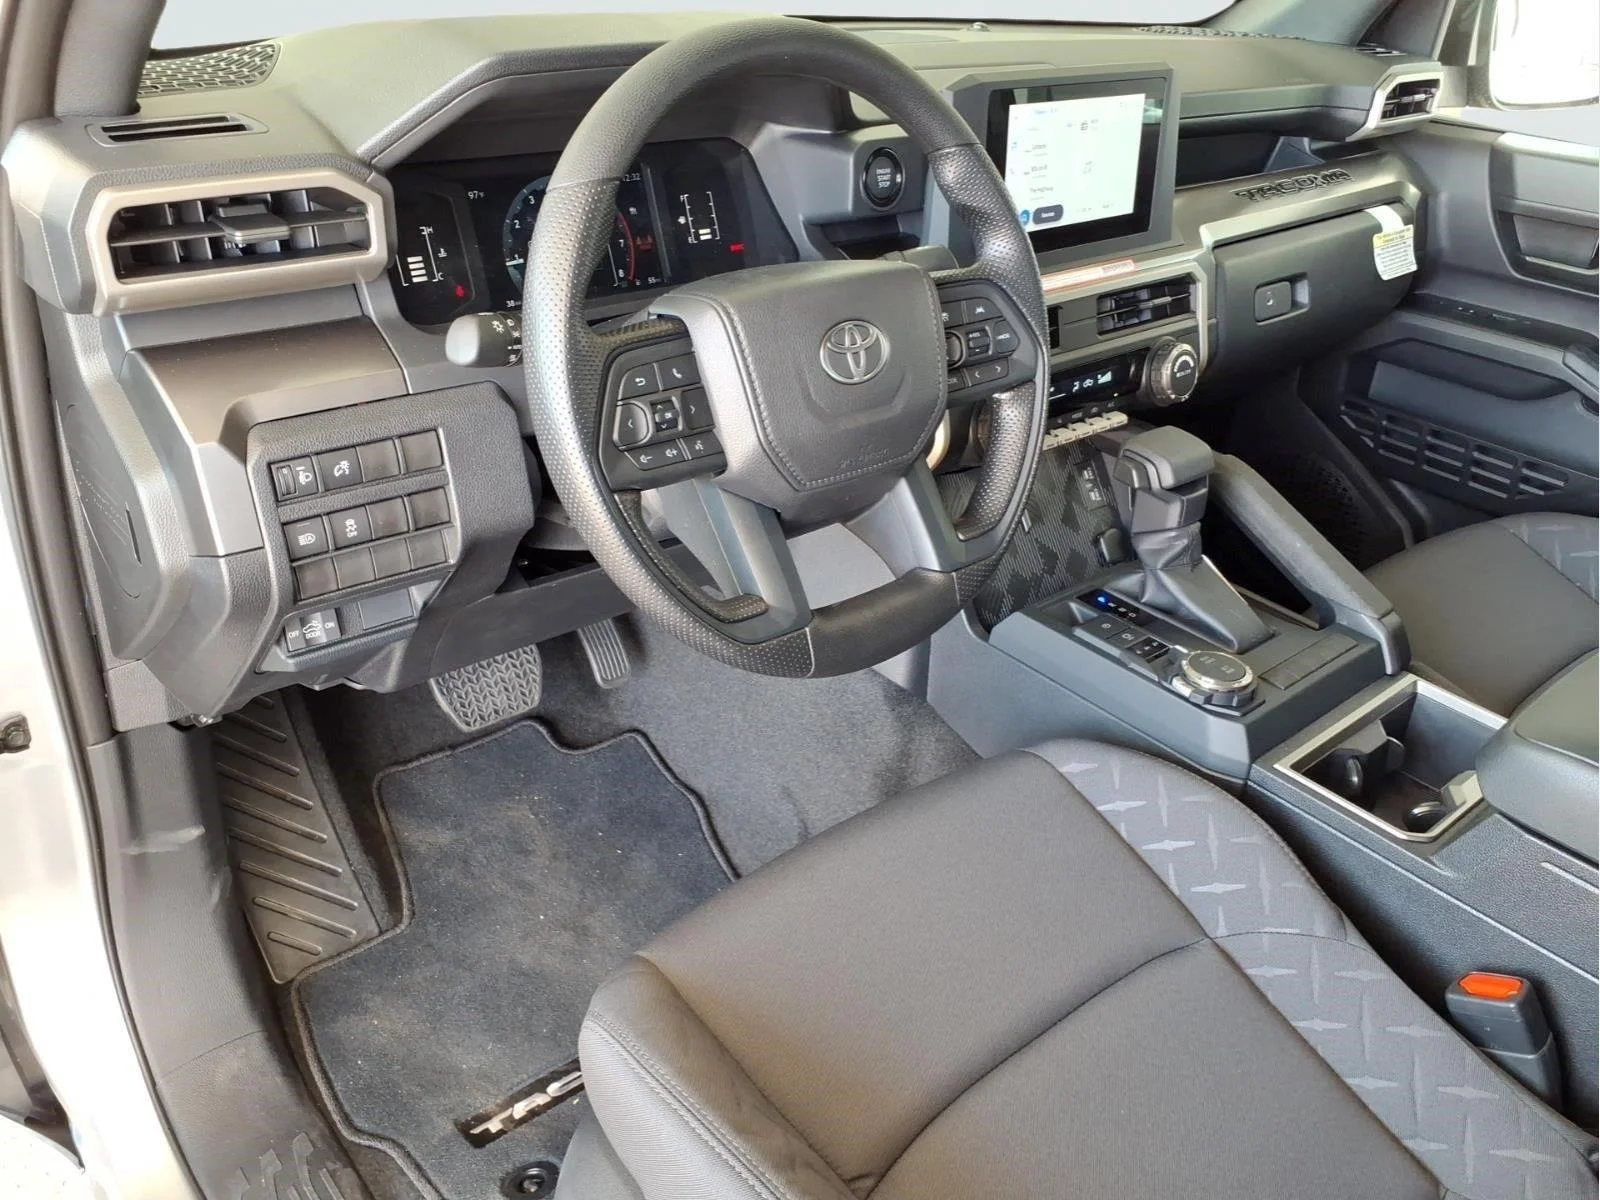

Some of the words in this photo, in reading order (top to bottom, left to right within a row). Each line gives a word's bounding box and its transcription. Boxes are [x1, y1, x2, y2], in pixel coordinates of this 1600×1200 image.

[1235, 168, 1352, 202] TACOMA
[529, 196, 535, 204] 3
[514, 220, 520, 229] 2
[324, 621, 335, 629] ON
[288, 630, 300, 639] OFF
